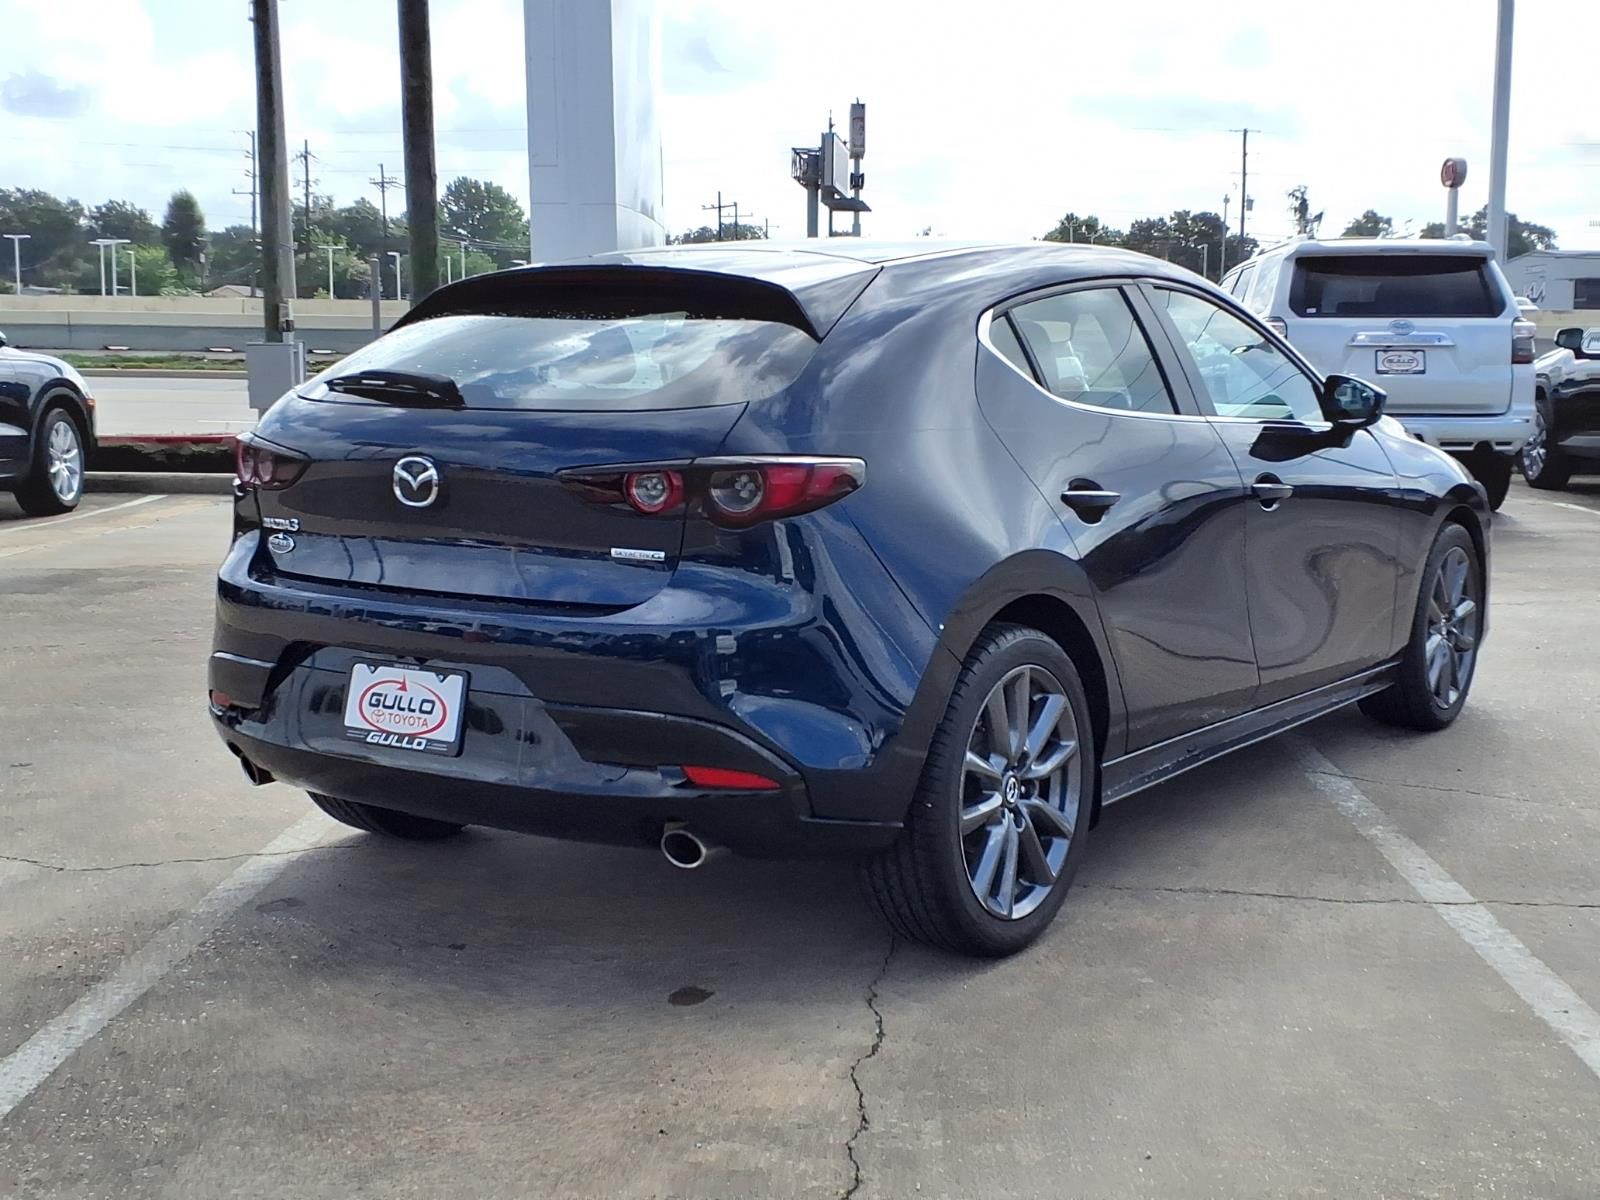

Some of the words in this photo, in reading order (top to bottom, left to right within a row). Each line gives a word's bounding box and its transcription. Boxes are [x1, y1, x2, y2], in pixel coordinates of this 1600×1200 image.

[369, 692, 436, 715] GULLO
[387, 712, 429, 728] TOYOTA
[366, 731, 427, 750] GULLO
